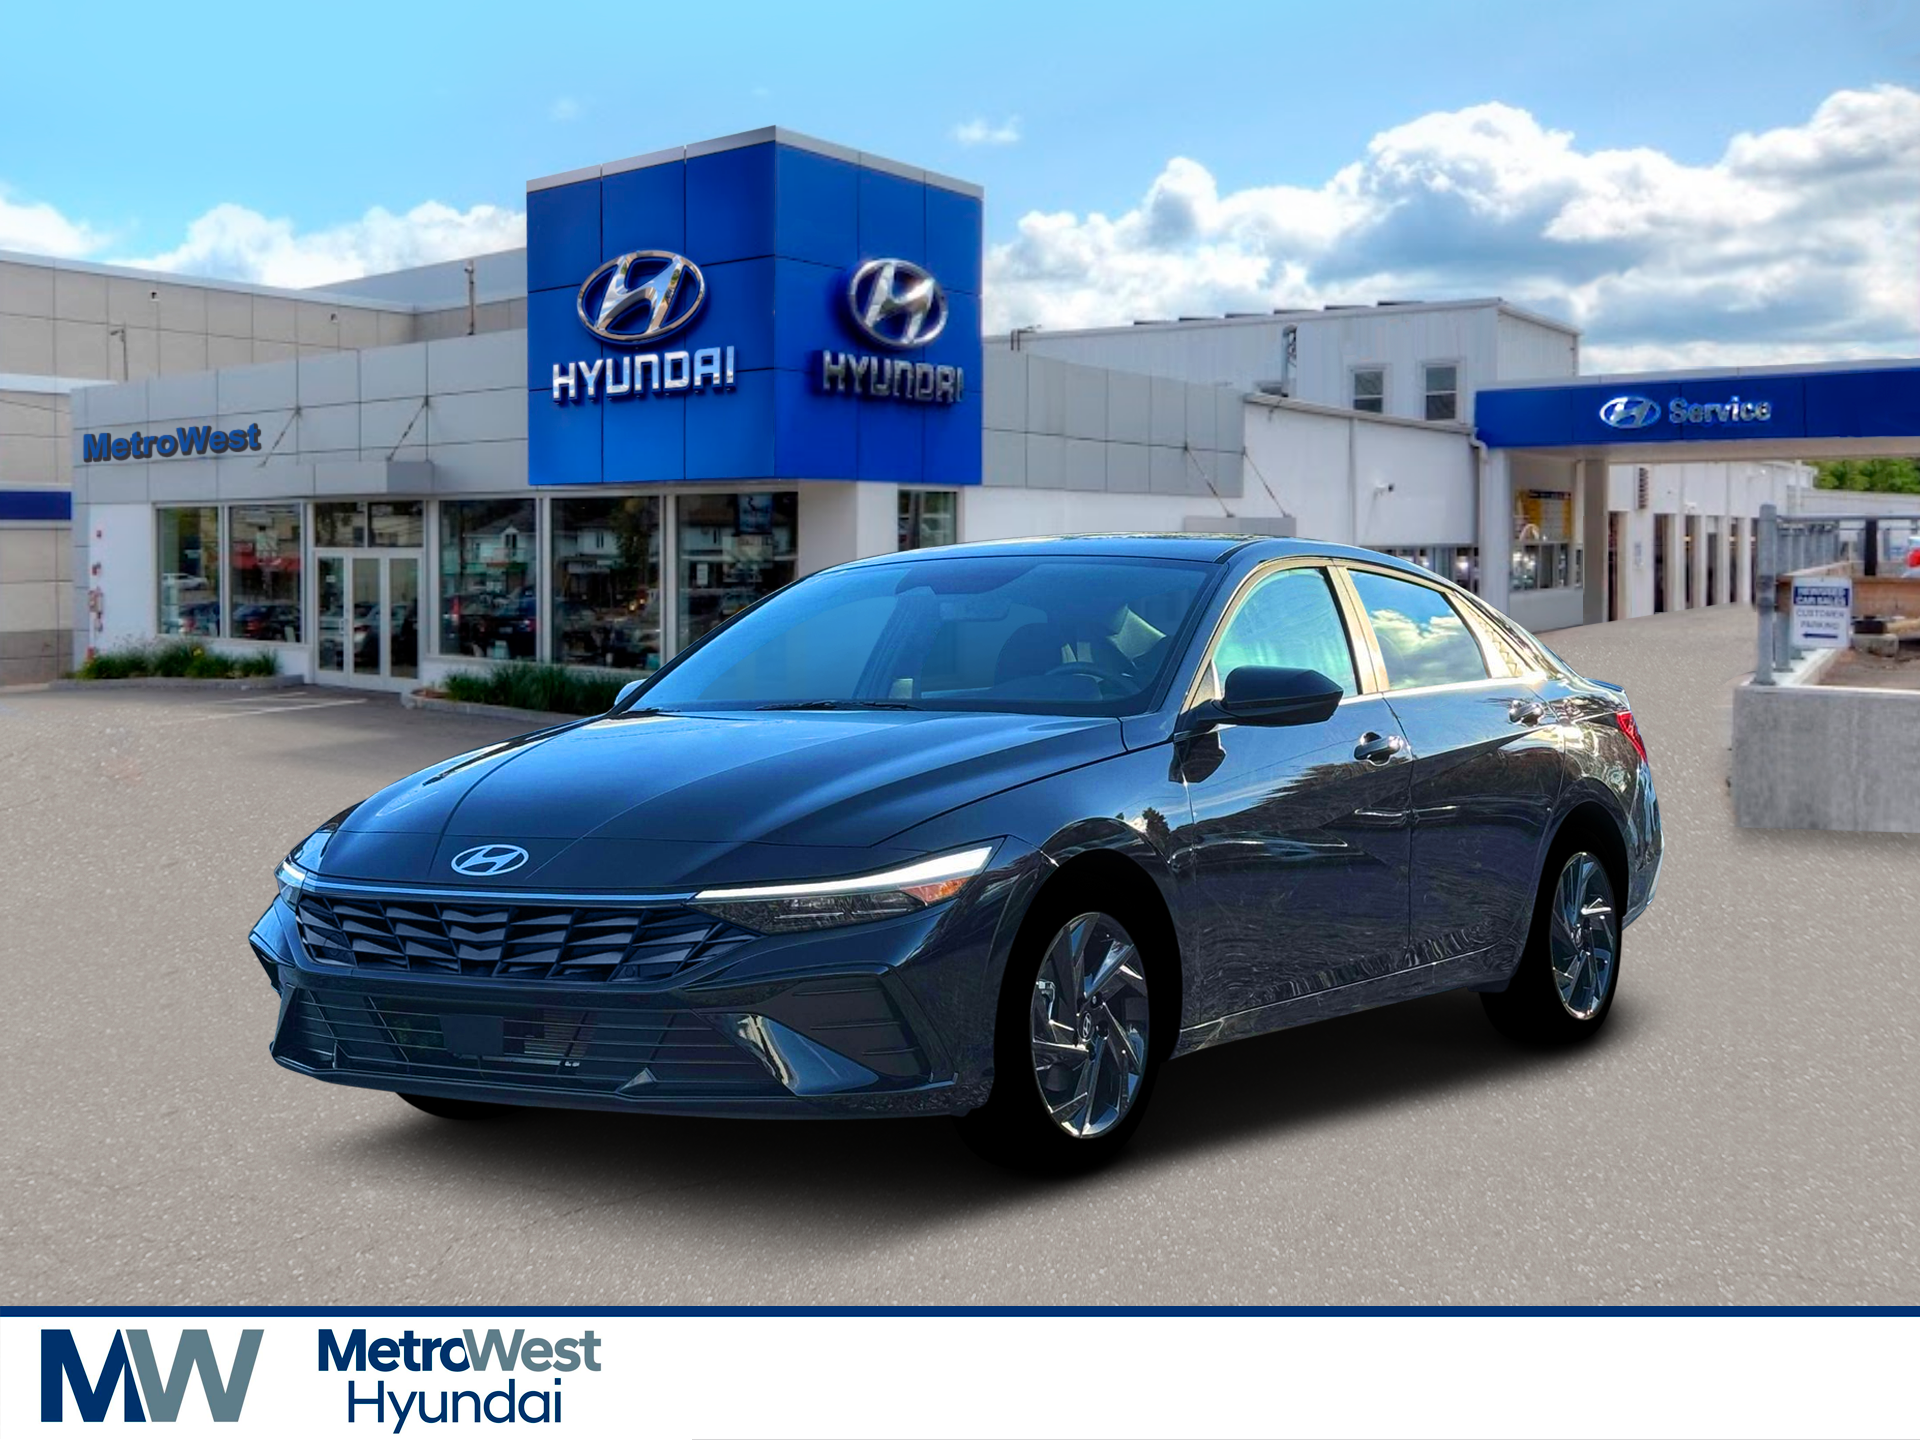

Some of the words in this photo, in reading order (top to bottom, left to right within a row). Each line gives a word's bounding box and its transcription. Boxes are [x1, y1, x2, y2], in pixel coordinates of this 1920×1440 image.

[553, 346, 735, 399] HYUNDAI
[823, 350, 964, 403] HYUNDAI
[1669, 396, 1772, 423] Service
[83, 423, 261, 462] MetroWest
[1796, 596, 1815, 605] CAR
[1796, 609, 1845, 618] CUSTOMER
[1800, 621, 1840, 630] PARKING
